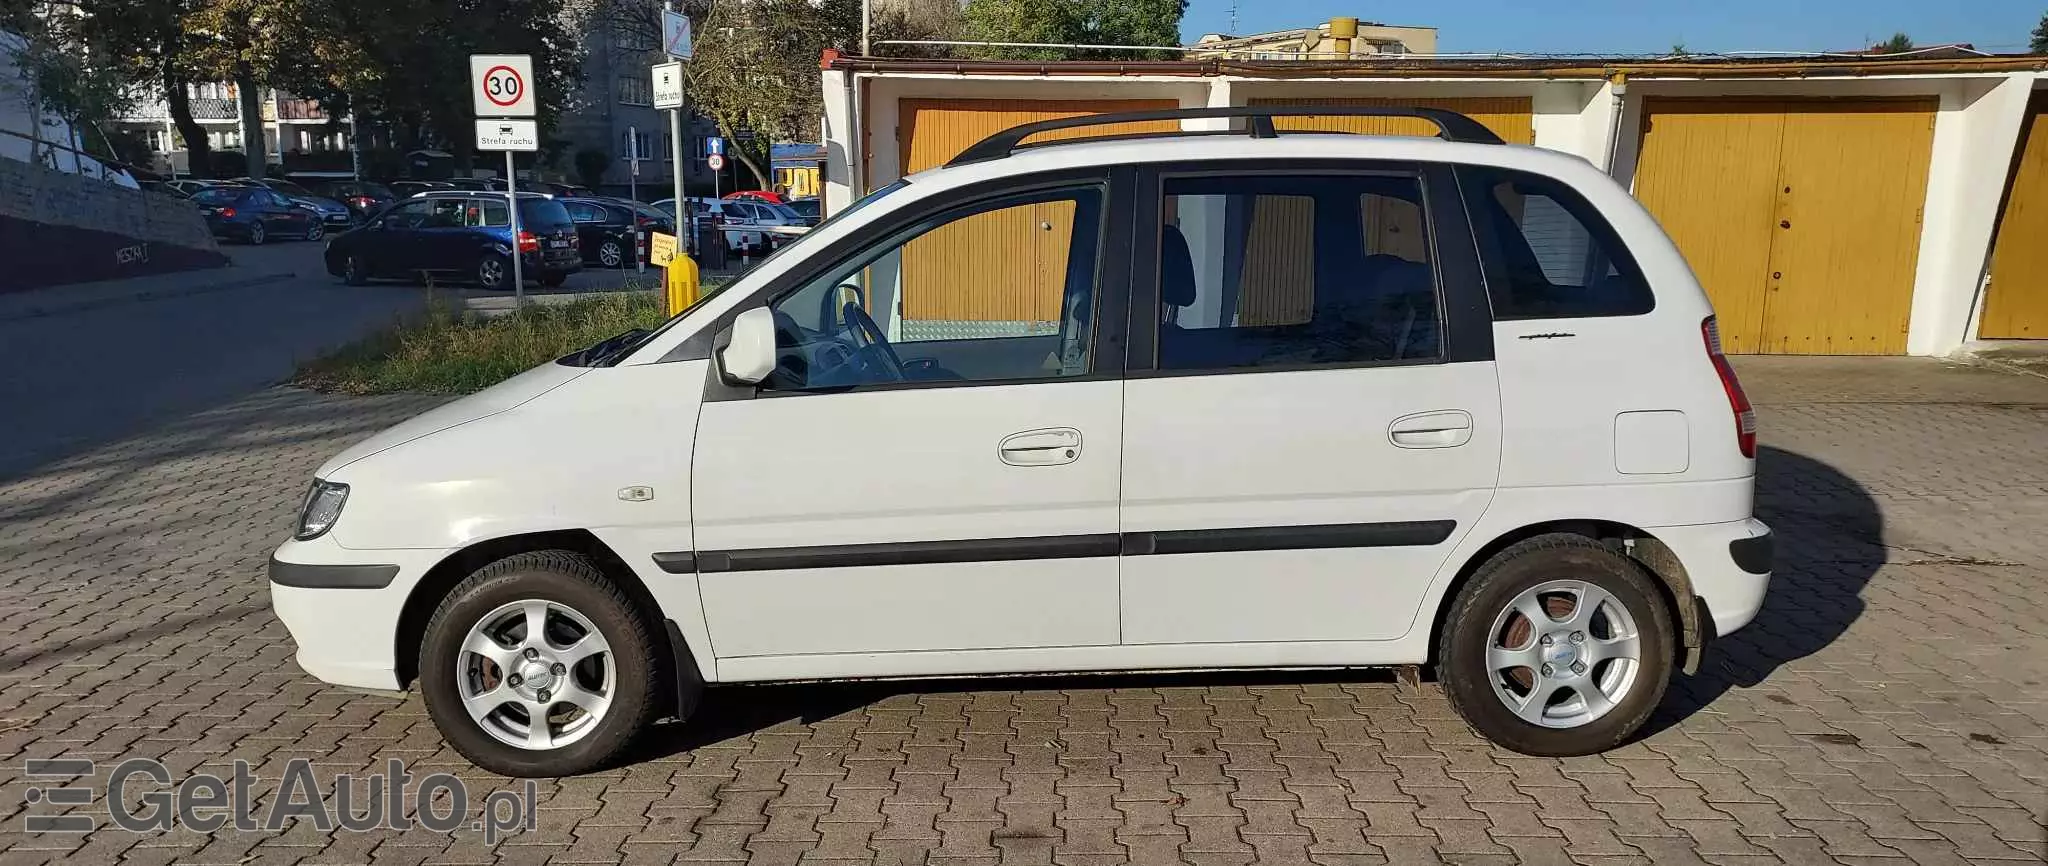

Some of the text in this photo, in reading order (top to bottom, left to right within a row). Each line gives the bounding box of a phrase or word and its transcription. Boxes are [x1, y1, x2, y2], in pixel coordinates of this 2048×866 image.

[489, 76, 518, 96] 30
[481, 137, 533, 145] Strefa ruchu
[711, 157, 720, 167] 30
